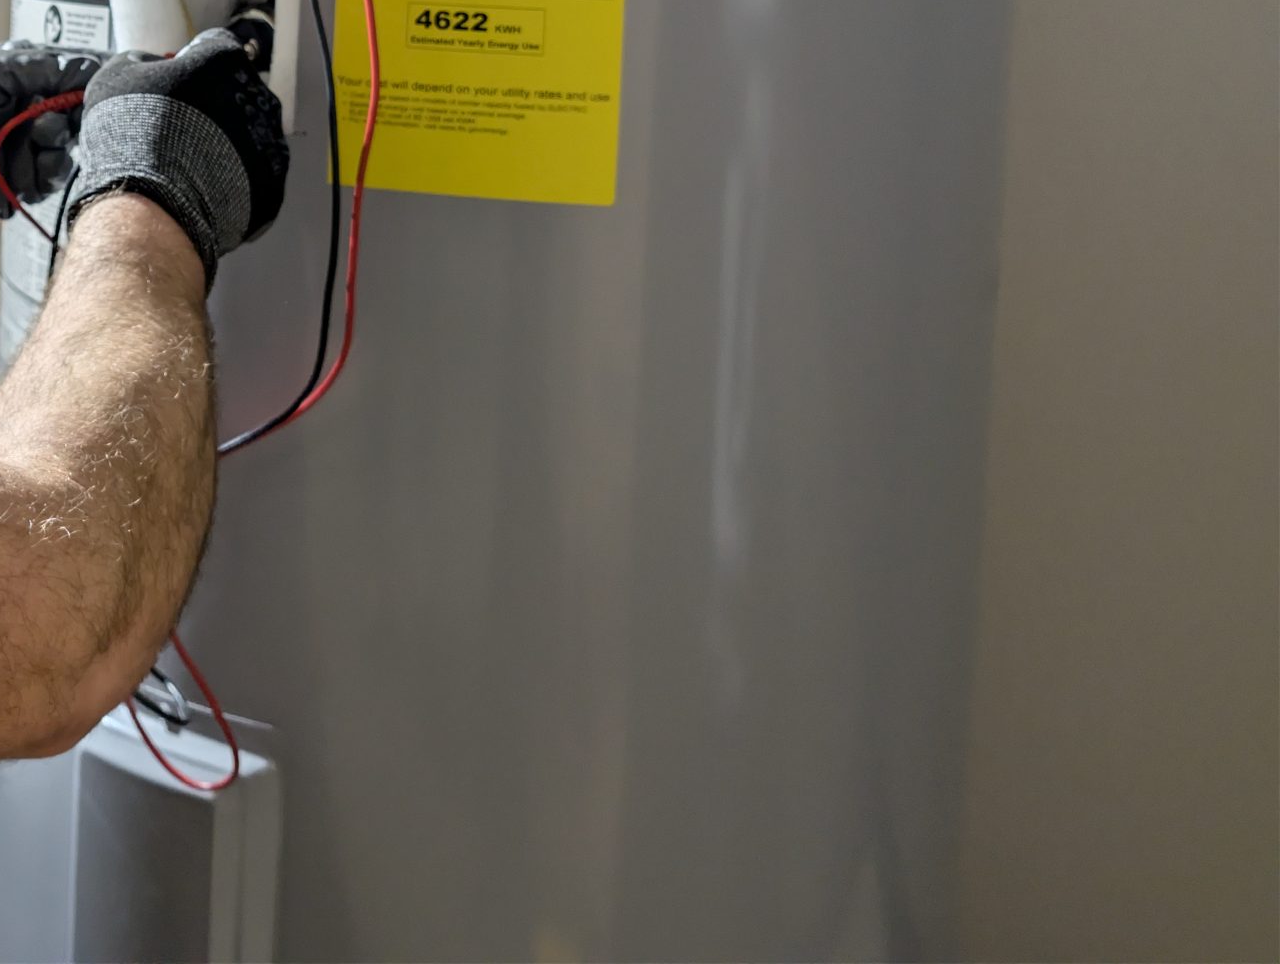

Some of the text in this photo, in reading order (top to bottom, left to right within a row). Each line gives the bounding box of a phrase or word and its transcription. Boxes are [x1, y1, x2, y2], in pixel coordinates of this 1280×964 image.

[415, 9, 522, 34] 4622 KWH
[410, 36, 540, 51] Estimated Yearly Energy Use
[391, 80, 409, 90] will
[411, 81, 453, 94] depend
[456, 85, 470, 93] on
[474, 86, 498, 97] your
[501, 87, 530, 100] utility
[534, 89, 562, 100] rates
[565, 91, 587, 101] and
[589, 93, 611, 102] use
